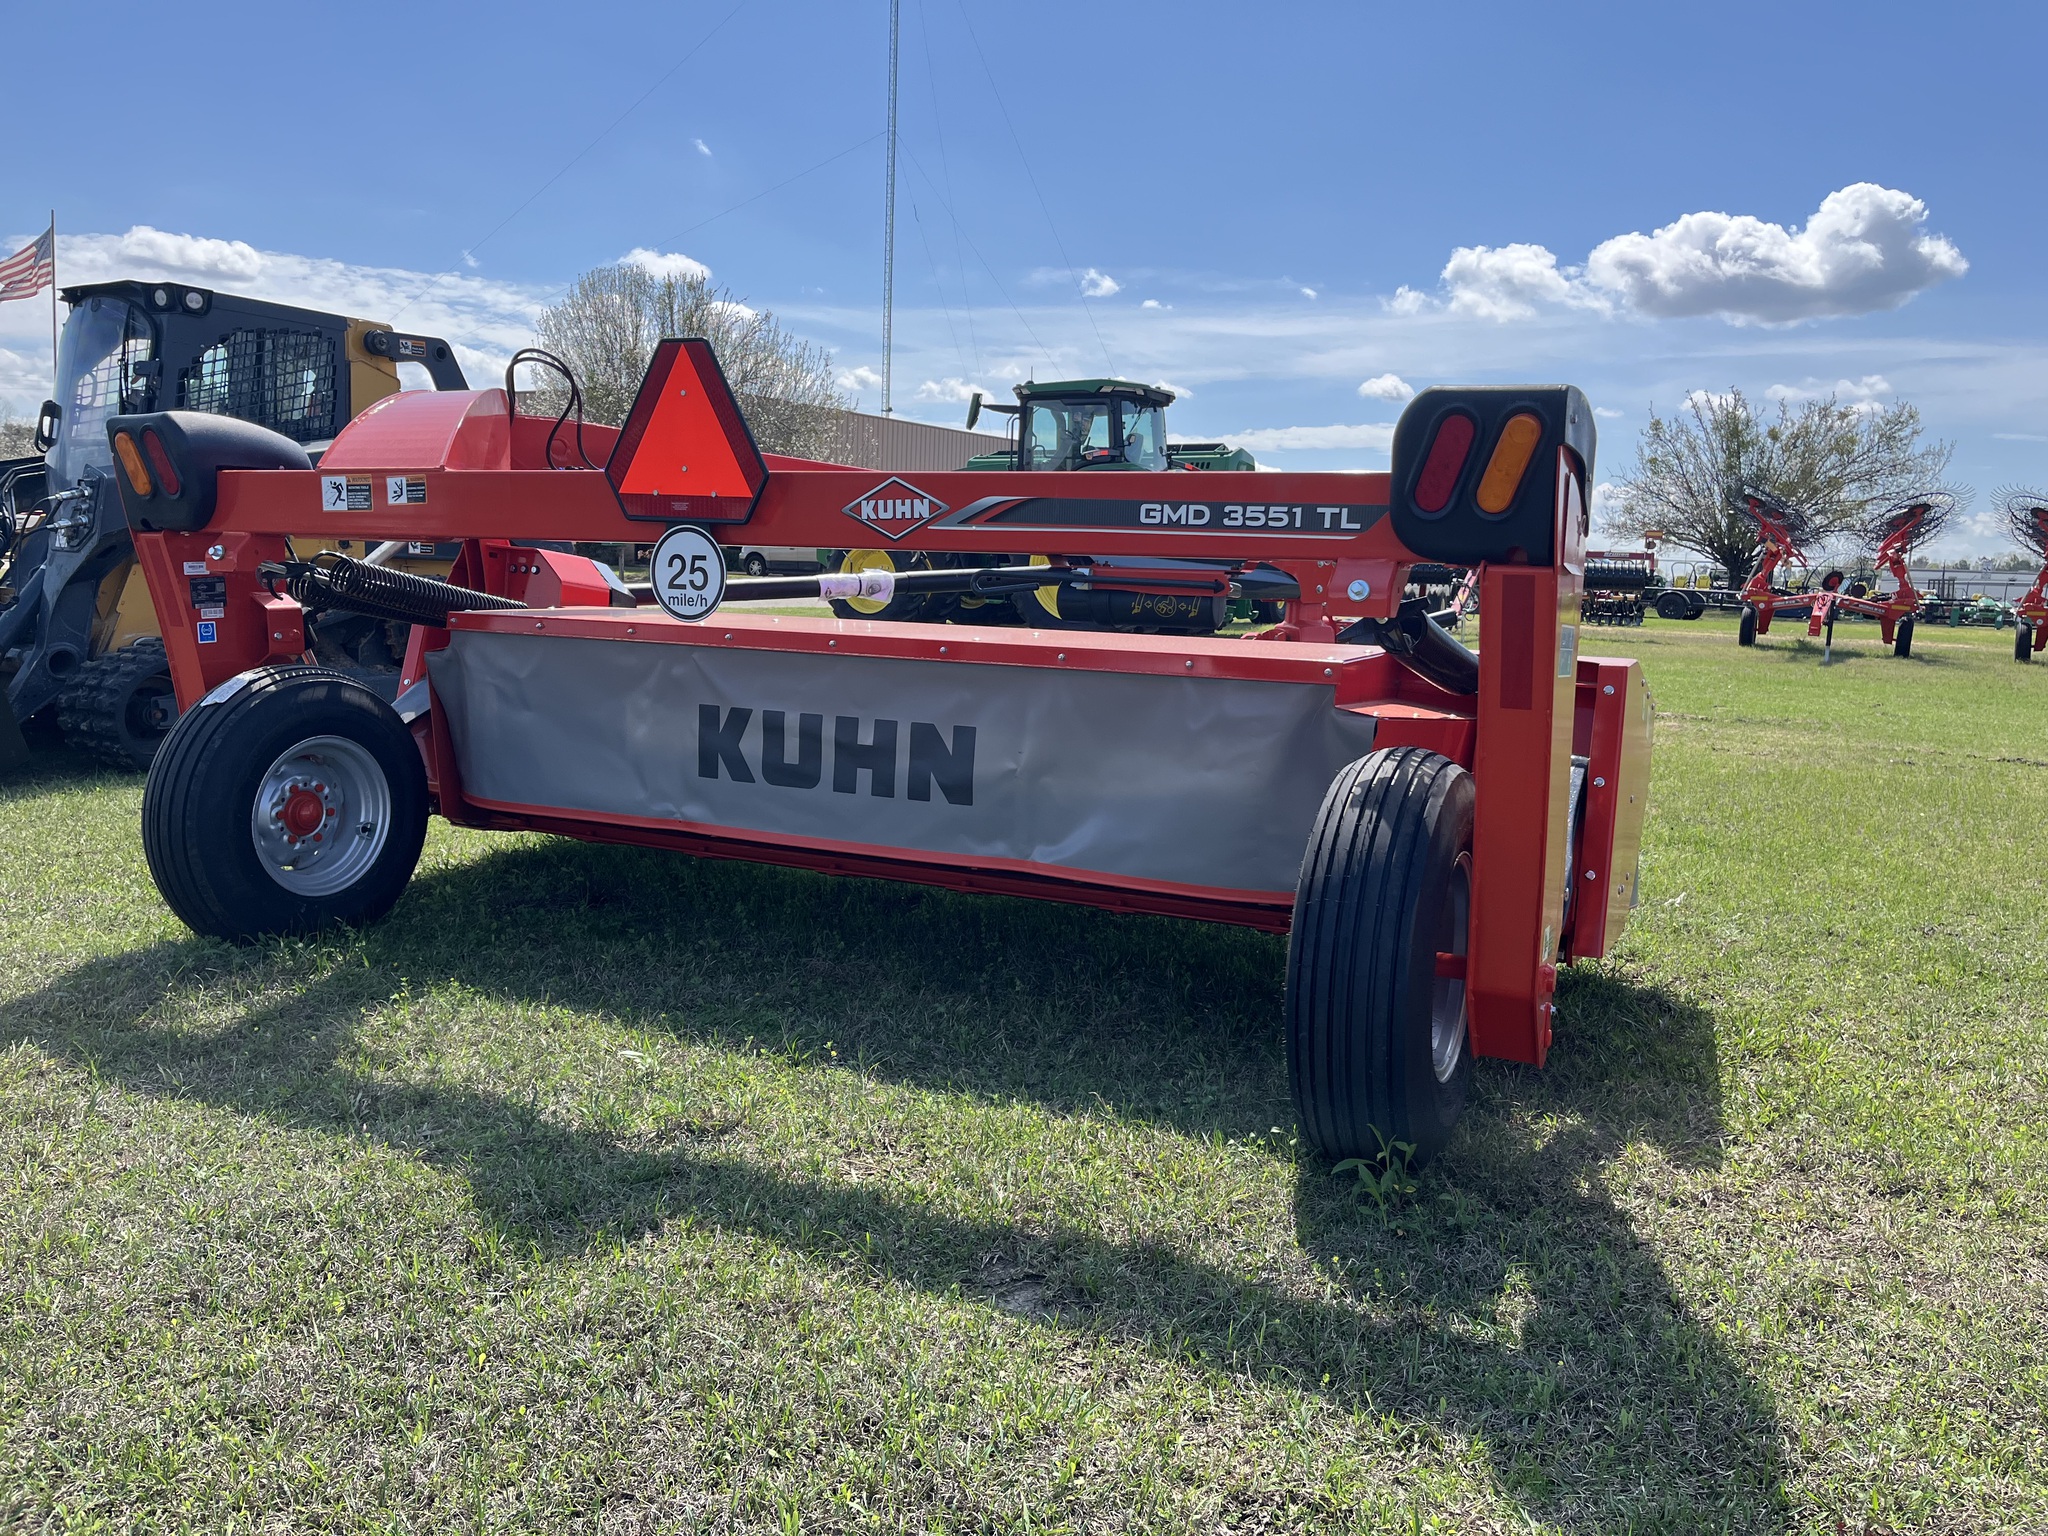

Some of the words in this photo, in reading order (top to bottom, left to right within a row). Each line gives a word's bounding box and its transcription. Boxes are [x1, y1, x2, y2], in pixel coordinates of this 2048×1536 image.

[861, 499, 930, 520] KUHN
[1139, 503, 1211, 526] GMD
[1222, 505, 1302, 528] 3551
[1316, 507, 1361, 530] TL
[667, 553, 709, 591] 25
[668, 593, 708, 607] mile/h
[698, 703, 977, 806] KUHN
